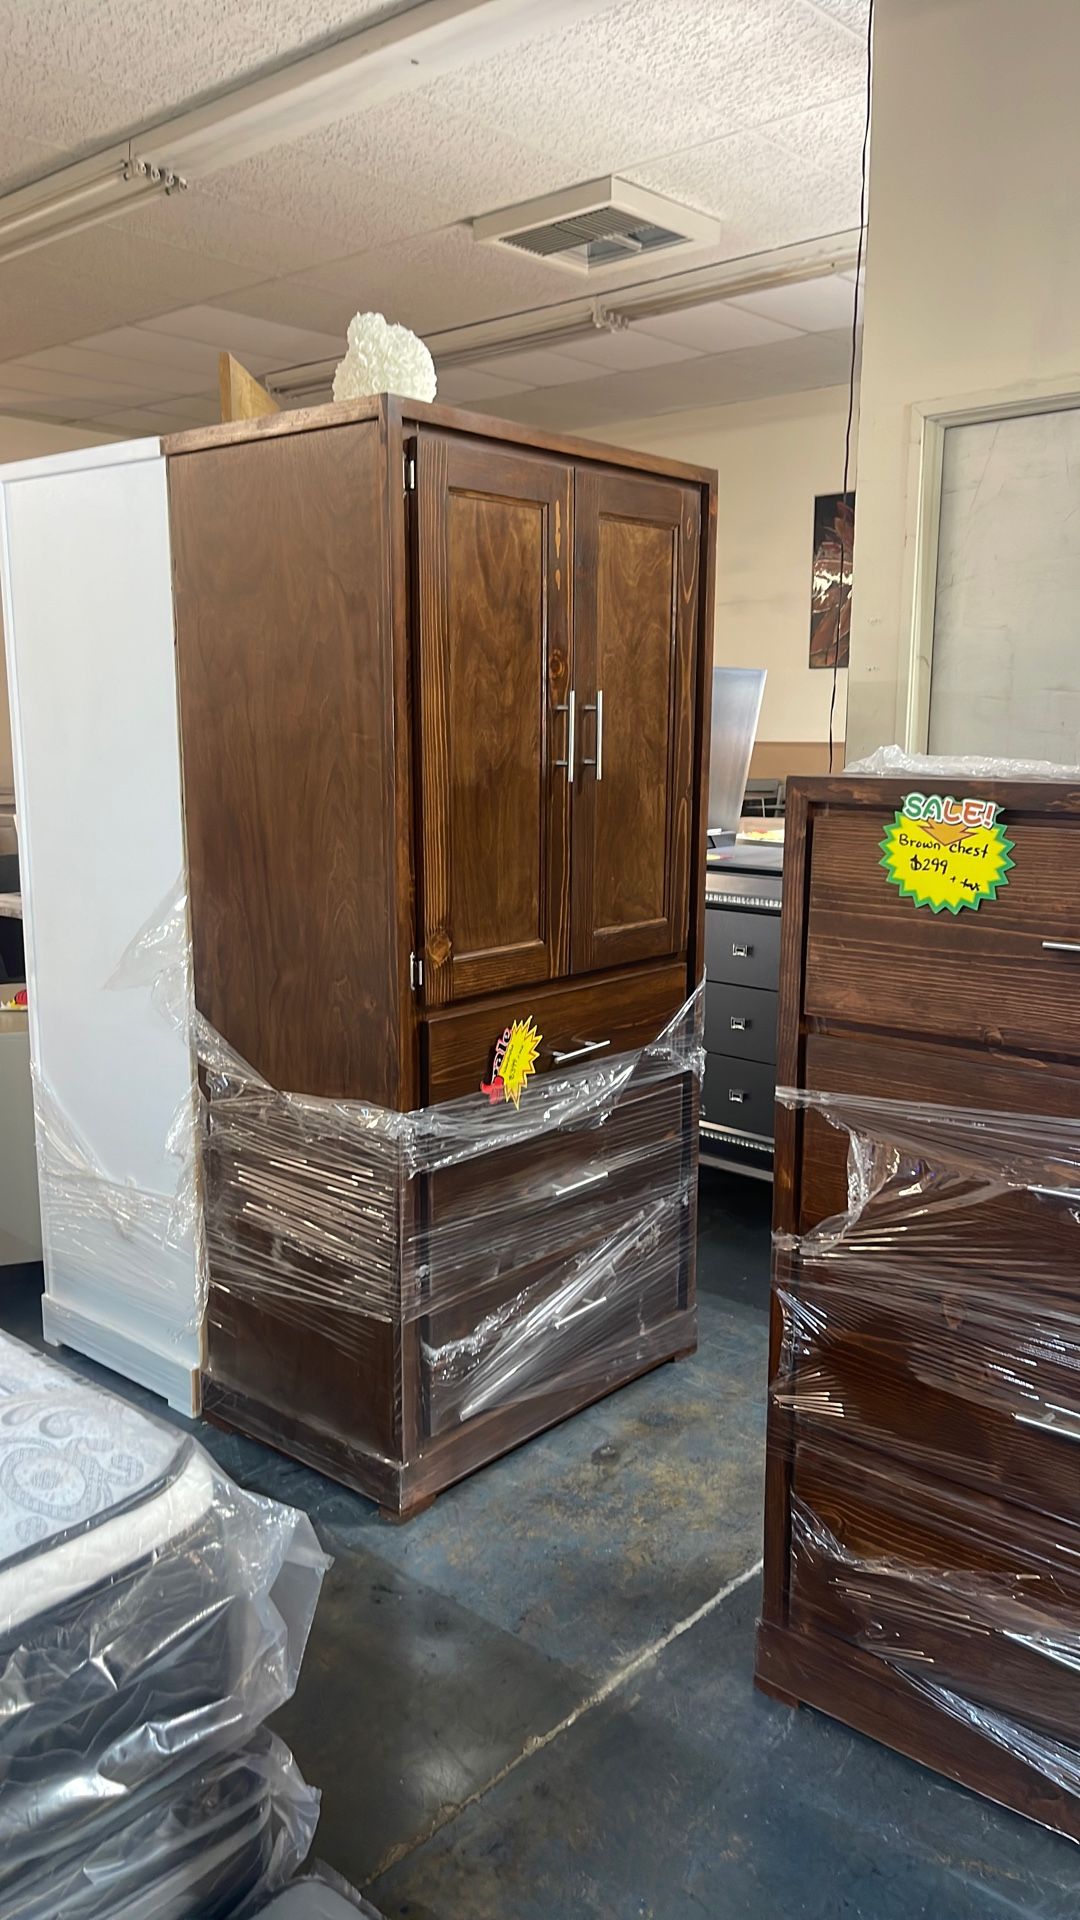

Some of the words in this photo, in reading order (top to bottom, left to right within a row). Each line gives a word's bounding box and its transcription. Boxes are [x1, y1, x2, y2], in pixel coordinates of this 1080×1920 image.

[904, 795, 995, 827] SALE!
[899, 833, 941, 850] Brown
[910, 854, 948, 875] $299
